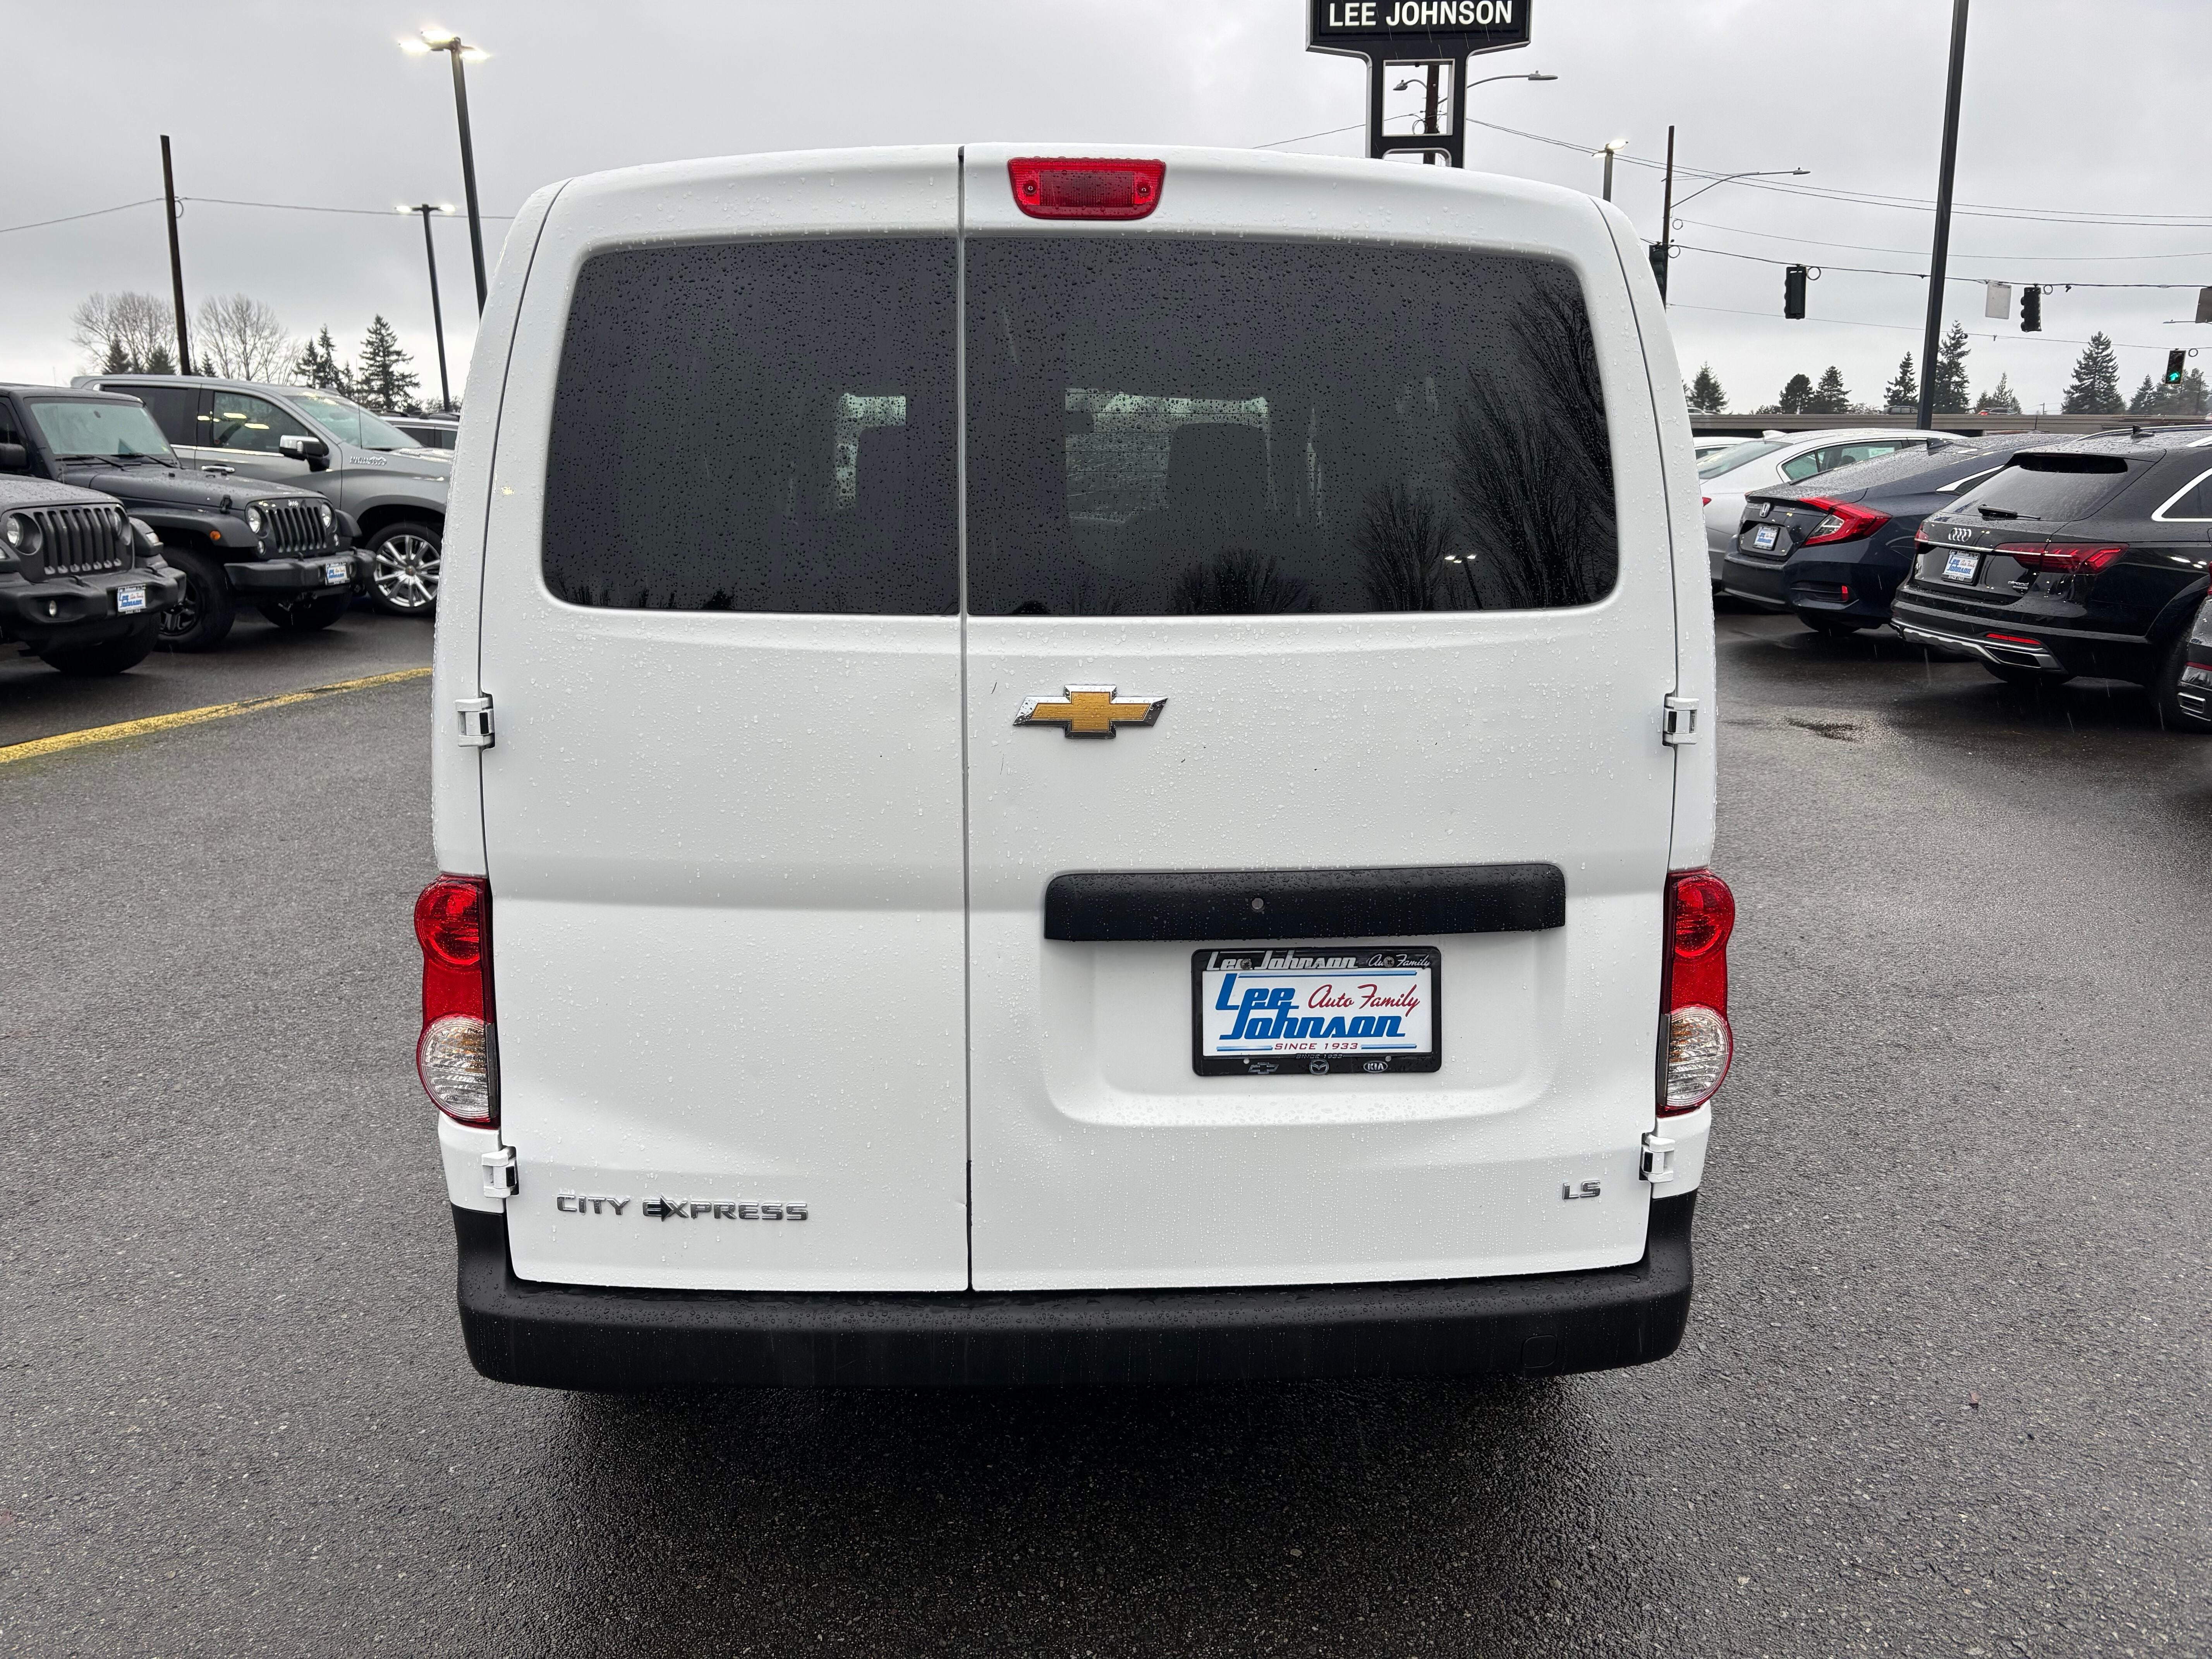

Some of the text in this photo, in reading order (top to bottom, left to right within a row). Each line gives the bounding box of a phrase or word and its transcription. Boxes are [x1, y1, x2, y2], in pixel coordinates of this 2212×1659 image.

[1329, 0, 1513, 27] LEE JOHNSON
[1254, 950, 1358, 970] Johnson
[1396, 954, 1431, 969] Family
[1215, 973, 1299, 1010] Lee
[1308, 984, 1420, 1017] Auto Family
[1219, 1007, 1406, 1040] Johnson
[1562, 1180, 1601, 1200] LS
[556, 1194, 809, 1221] CITY EXPRESS
